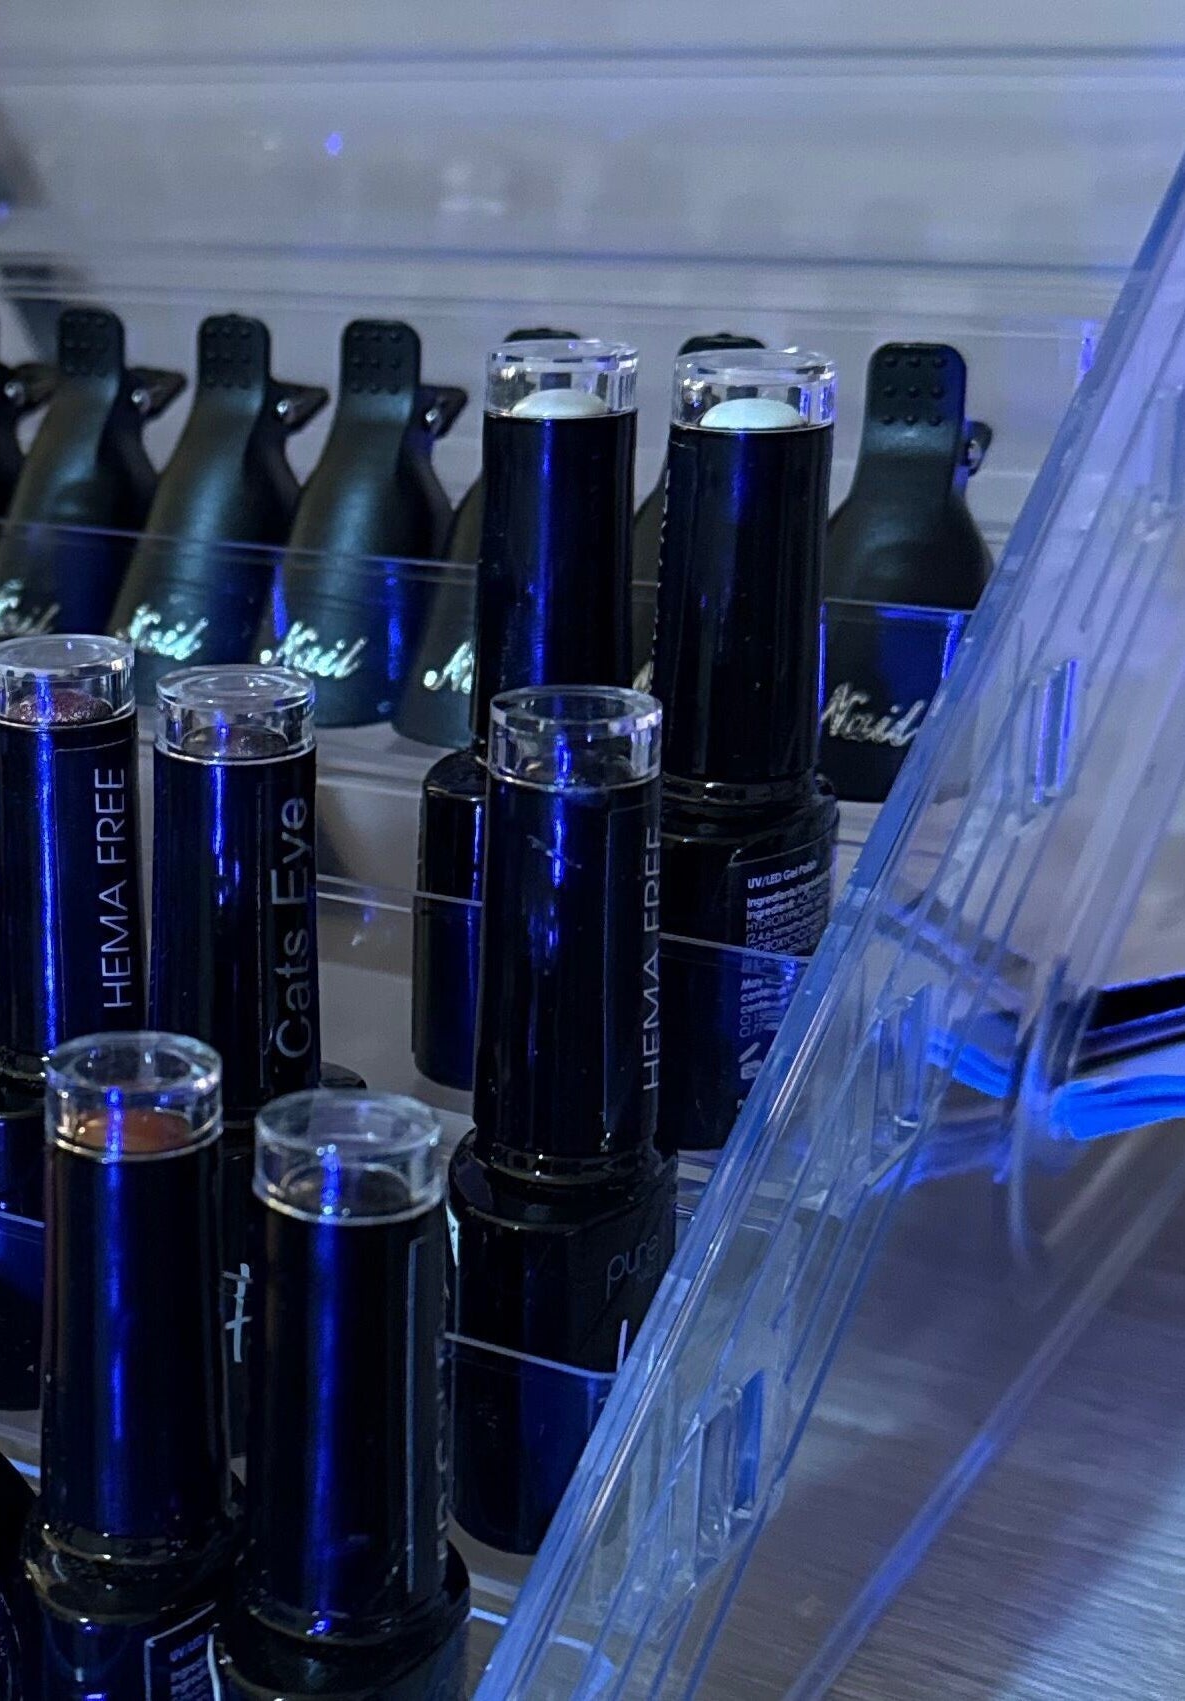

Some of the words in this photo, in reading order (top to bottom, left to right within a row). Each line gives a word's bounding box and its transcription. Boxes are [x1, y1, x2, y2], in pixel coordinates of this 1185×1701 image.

[820, 682, 927, 747] Nail
[93, 767, 127, 865] FREE
[270, 795, 313, 906] Eye
[642, 826, 661, 932] FREE
[97, 878, 133, 1008] HEMA
[274, 929, 312, 1060] Cats
[642, 948, 661, 1091] HEMA
[606, 1234, 659, 1302] pure
